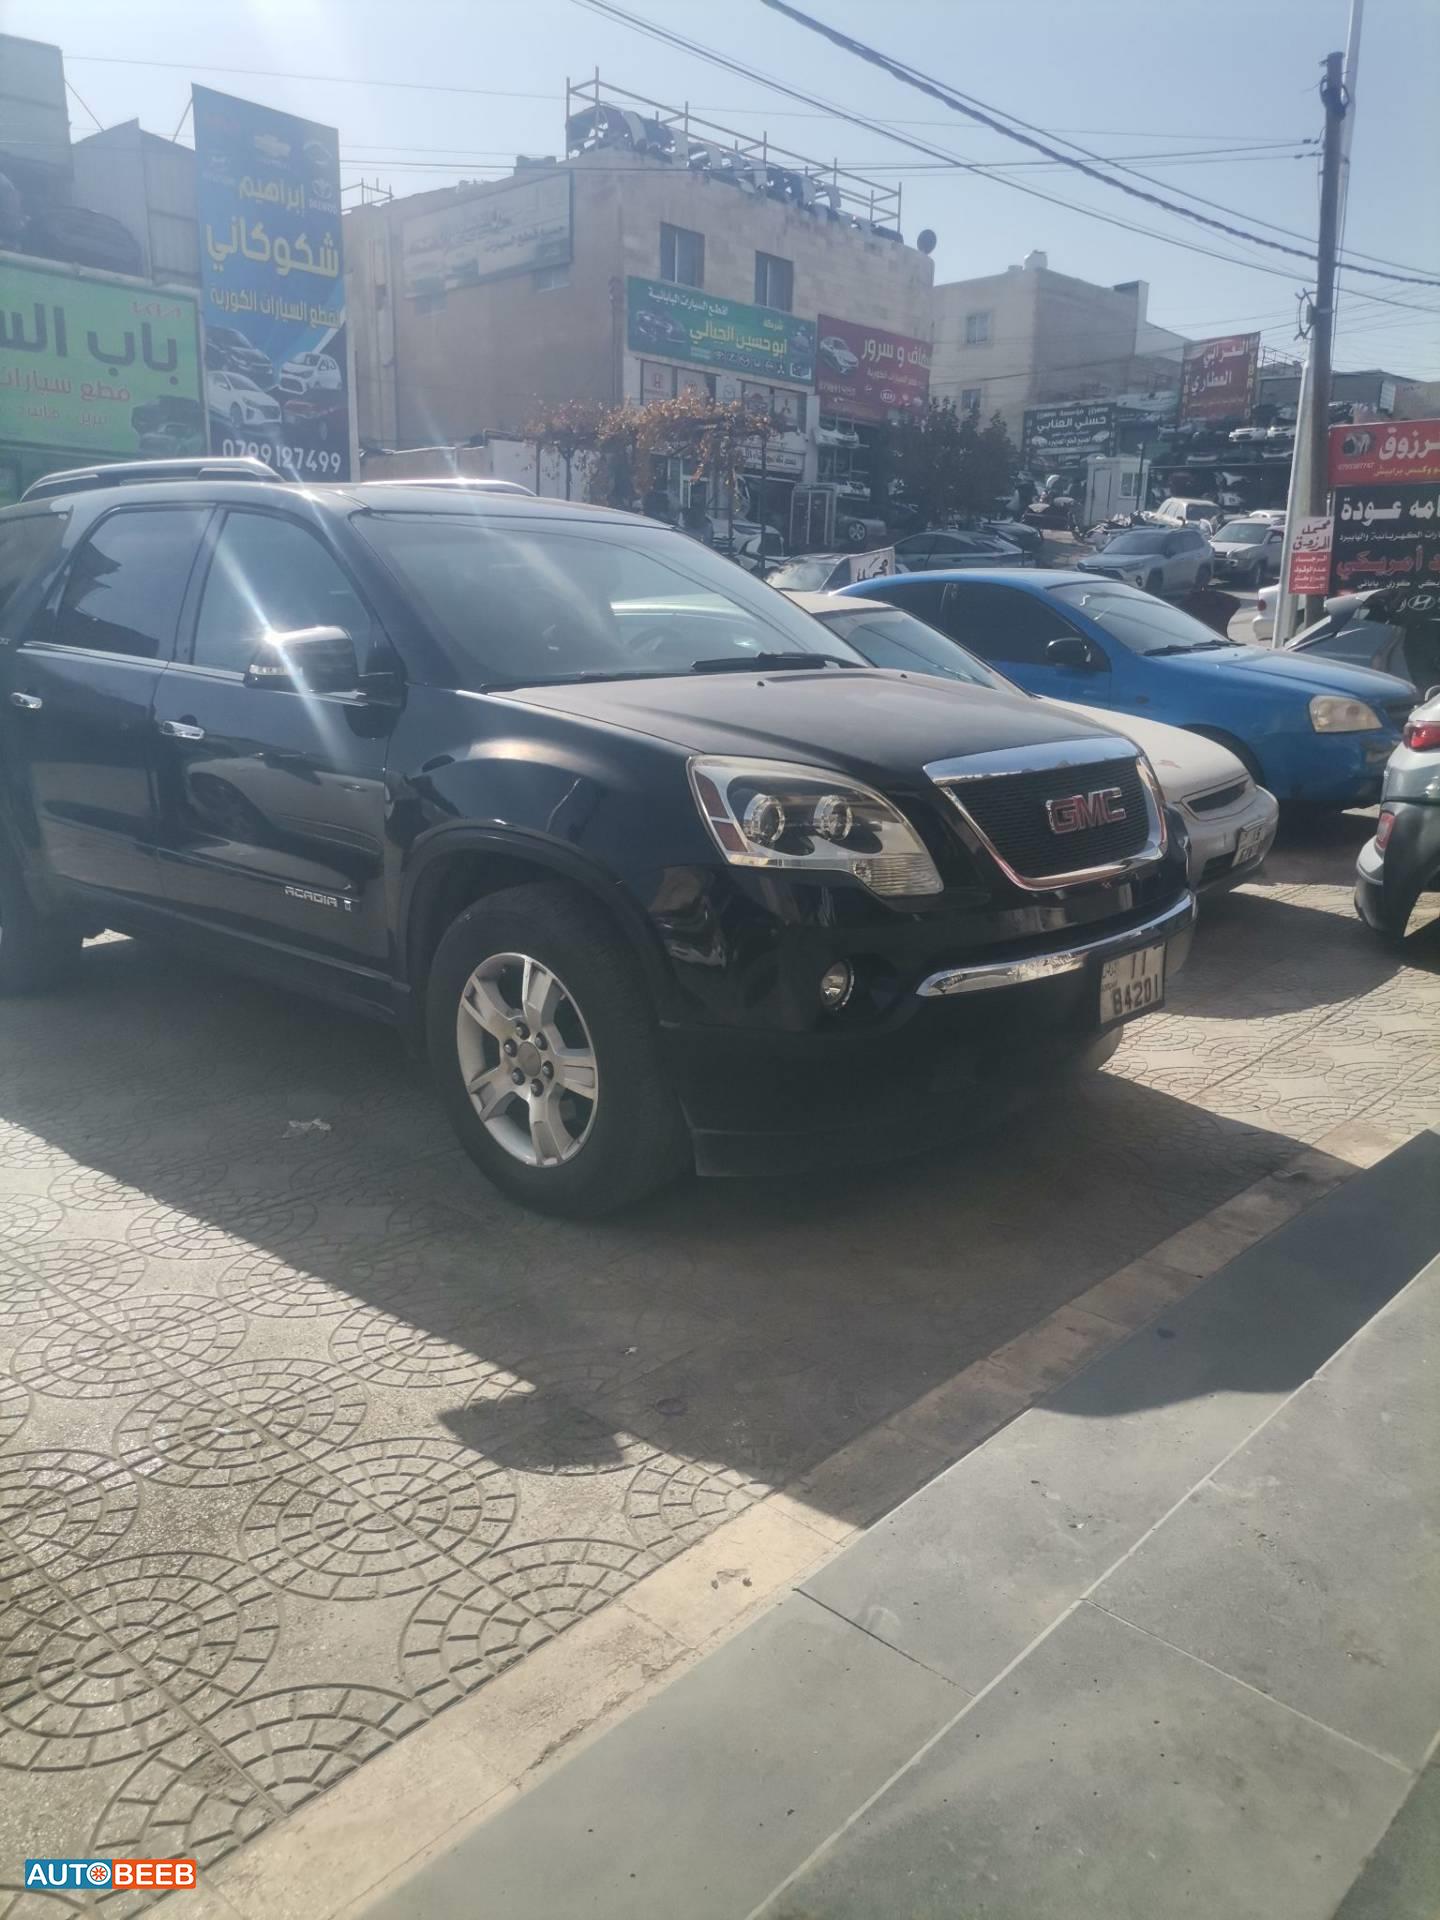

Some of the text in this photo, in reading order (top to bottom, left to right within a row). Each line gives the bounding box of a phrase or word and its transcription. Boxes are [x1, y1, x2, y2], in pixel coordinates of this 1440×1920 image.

[206, 216, 339, 278] شكوكاني
[260, 292, 308, 324] السيارات
[0, 302, 179, 386] باب الس
[860, 338, 894, 364] سرور
[1378, 426, 1440, 461] رزوق
[1341, 497, 1403, 528] عودة
[1044, 786, 1127, 834] GMC
[284, 885, 338, 909] ACADIA
